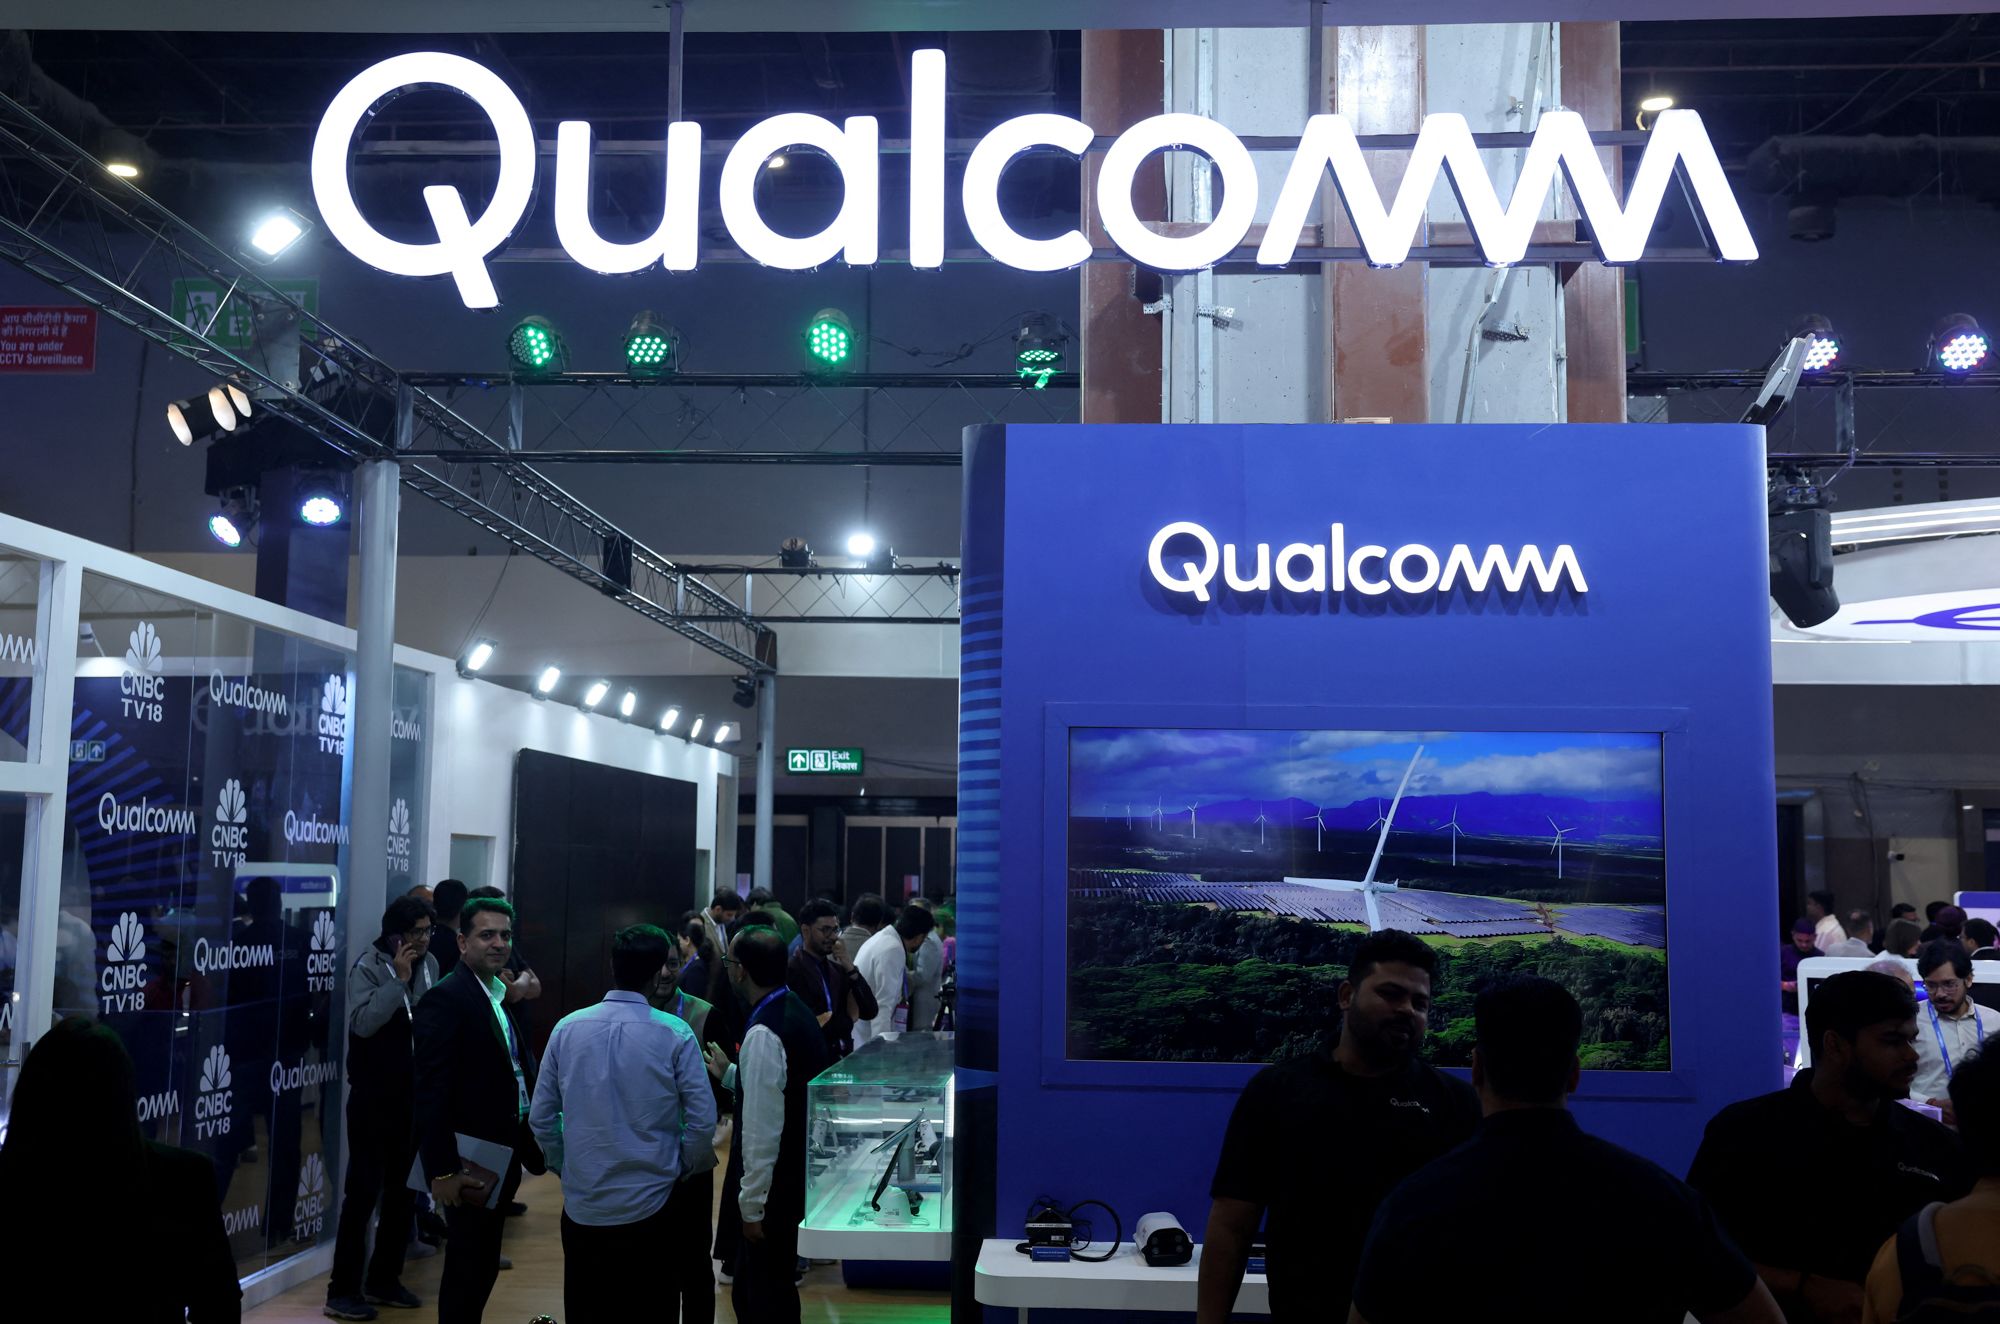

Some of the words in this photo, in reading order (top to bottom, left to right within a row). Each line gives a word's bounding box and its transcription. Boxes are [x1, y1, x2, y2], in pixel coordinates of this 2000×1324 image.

[310, 48, 1760, 310] Qualcomm
[0, 339, 17, 351] You
[19, 342, 35, 351] are
[37, 341, 64, 351] under
[0, 353, 24, 364] CCTV
[26, 353, 84, 365] Surveillance
[1147, 520, 1590, 603] Qualcomm
[120, 670, 165, 701] CNBC
[209, 668, 287, 716] Qualcomm
[121, 698, 163, 723] TV18
[831, 750, 850, 760] Exit
[99, 791, 196, 835] Qualcomm
[211, 825, 249, 850] CNBC
[284, 809, 350, 846] Qualcomm
[387, 834, 411, 856] CNBC
[212, 849, 247, 869] TV18
[387, 854, 409, 873] TV18
[193, 937, 274, 977] Qualcomm
[306, 952, 337, 975] CNBC
[101, 963, 147, 993] CNBC
[307, 976, 335, 992] TV18
[102, 995, 146, 1015] TV18
[270, 1059, 338, 1097] Qualcomm
[195, 1089, 233, 1121] CNBC
[195, 1116, 231, 1141] TV18
[294, 1192, 325, 1223] CNBC
[294, 1216, 323, 1241] TV18
